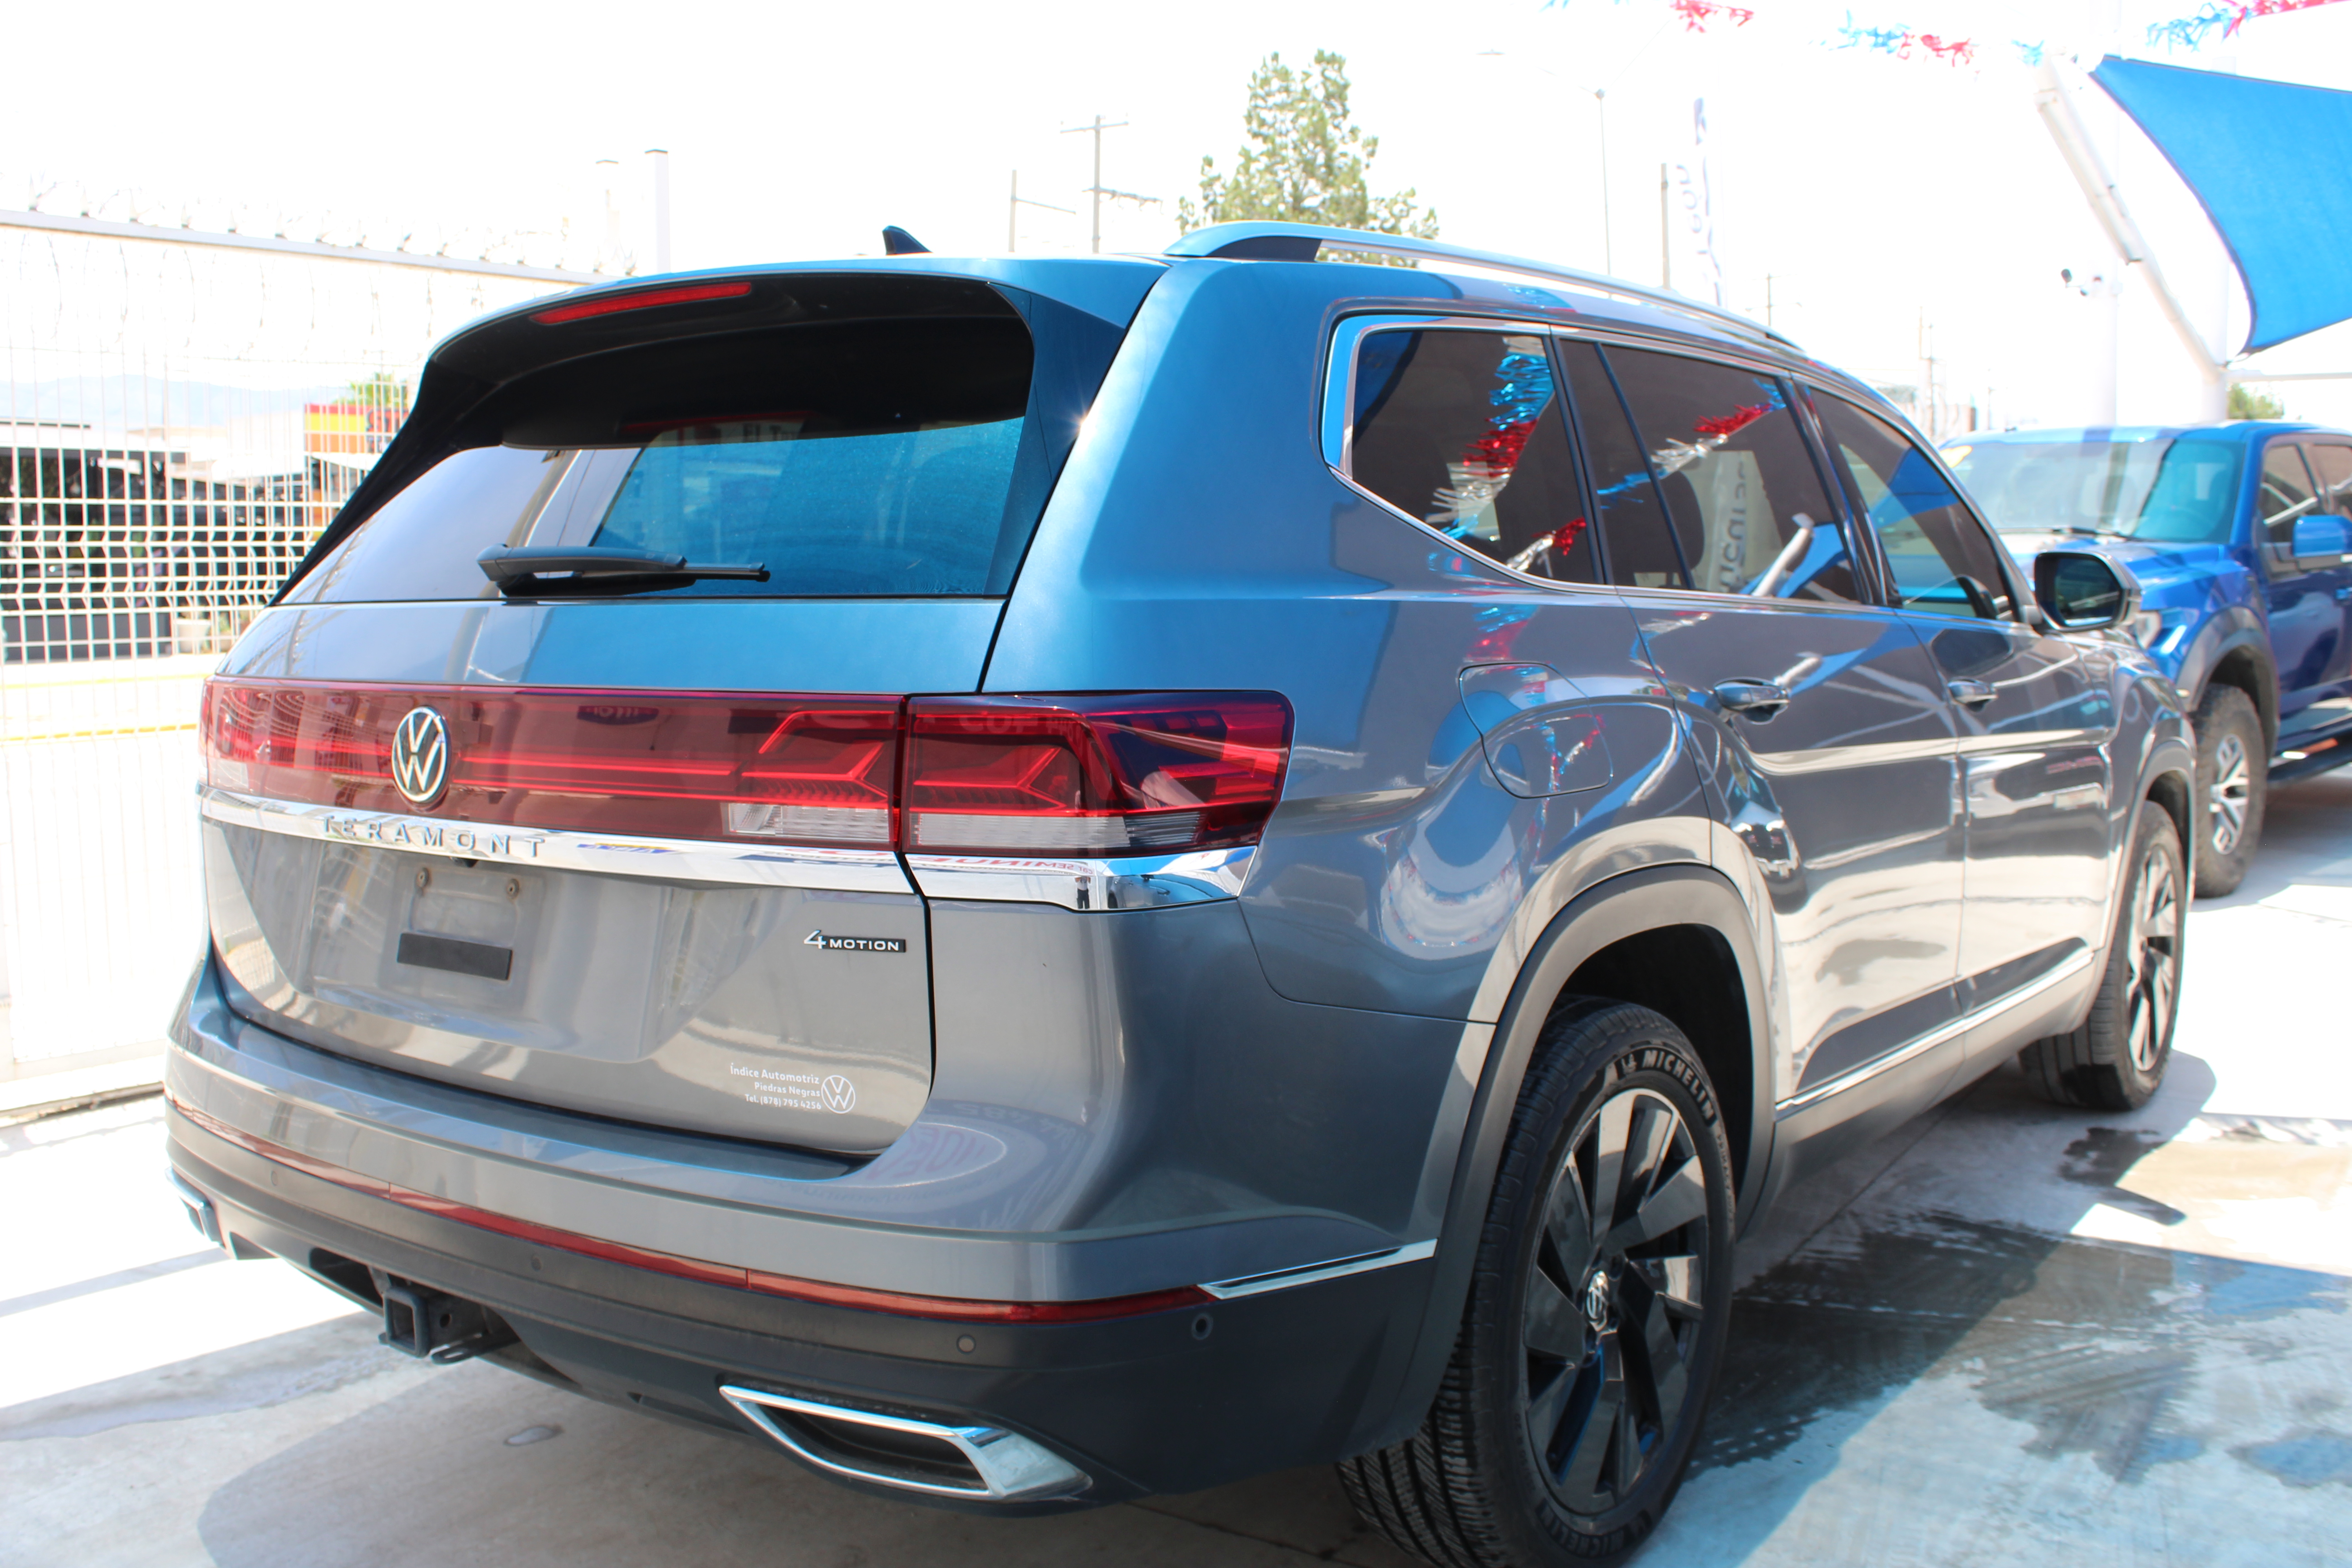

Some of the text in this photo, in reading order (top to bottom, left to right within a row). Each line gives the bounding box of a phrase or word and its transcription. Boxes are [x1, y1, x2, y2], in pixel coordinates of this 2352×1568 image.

[322, 816, 545, 857] TERAMONT
[804, 930, 899, 951] 4MOTION
[730, 1063, 819, 1084] Índice Automotriz
[755, 1082, 820, 1098] Piedras Negras
[1642, 1050, 1715, 1120] MICHELIN
[745, 1093, 822, 1110] Tel. (878) 795 4256
